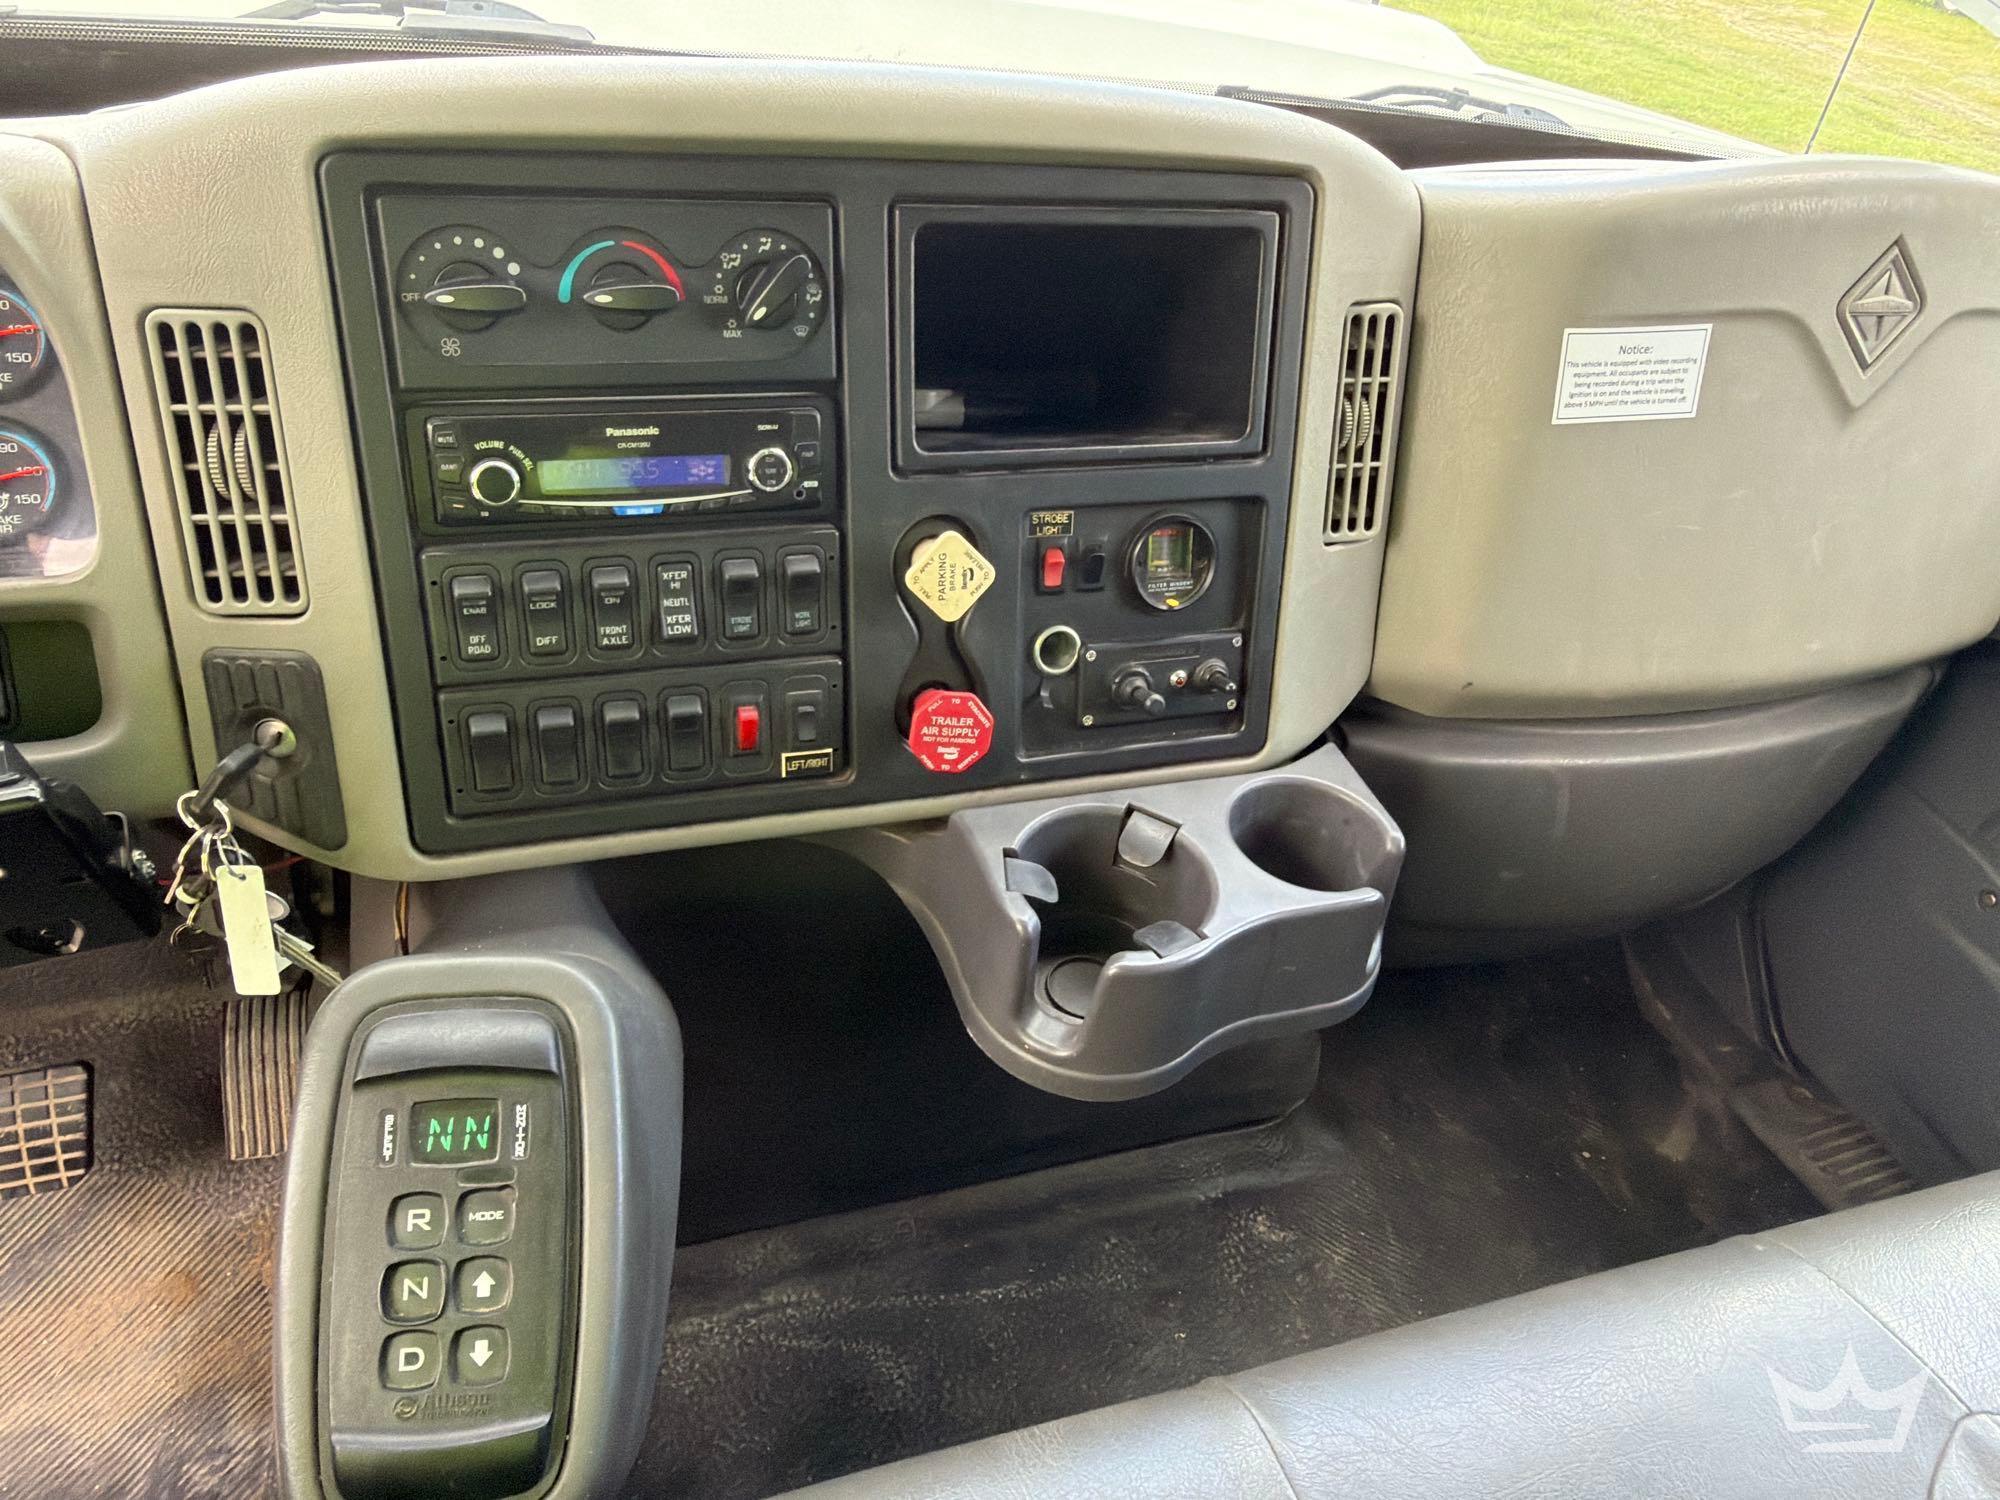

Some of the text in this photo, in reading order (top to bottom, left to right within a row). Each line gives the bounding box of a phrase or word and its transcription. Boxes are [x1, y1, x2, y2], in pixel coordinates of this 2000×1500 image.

[401, 293, 420, 302] OFF
[723, 330, 742, 338] MAX
[1618, 344, 1654, 355] Notice:
[5, 352, 32, 363] 150
[605, 426, 660, 437] Panasonic
[0, 443, 18, 453] 90
[474, 440, 505, 451] VOLUME
[508, 445, 525, 460] PUSH
[14, 494, 41, 504] 150
[1032, 513, 1070, 524] STROBE
[1036, 525, 1062, 536] LIGHT
[662, 571, 688, 580] XFER
[913, 575, 920, 585] TO
[938, 552, 947, 601] PARKING
[949, 562, 957, 592] BRAKE
[983, 571, 990, 580] TO
[670, 581, 681, 590] HI
[529, 601, 557, 610] LOCK
[604, 597, 621, 605] ON
[663, 598, 690, 607] NEUTL
[463, 607, 487, 615] ENAB
[666, 614, 692, 624] XFER
[600, 625, 628, 635] FRONT
[667, 625, 693, 635] LOW
[469, 634, 487, 644] OFF
[536, 636, 559, 646] DIFF
[602, 636, 629, 645] AXLE
[931, 716, 974, 726] TRAILER
[921, 726, 980, 737] AIR SUPPLY
[786, 757, 829, 771] LEFT/RIGHT
[515, 1104, 527, 1157] MONITOR
[406, 1209, 431, 1232] R
[468, 1210, 505, 1222] MODE
[402, 1276, 429, 1301] N
[398, 1347, 425, 1372] D
